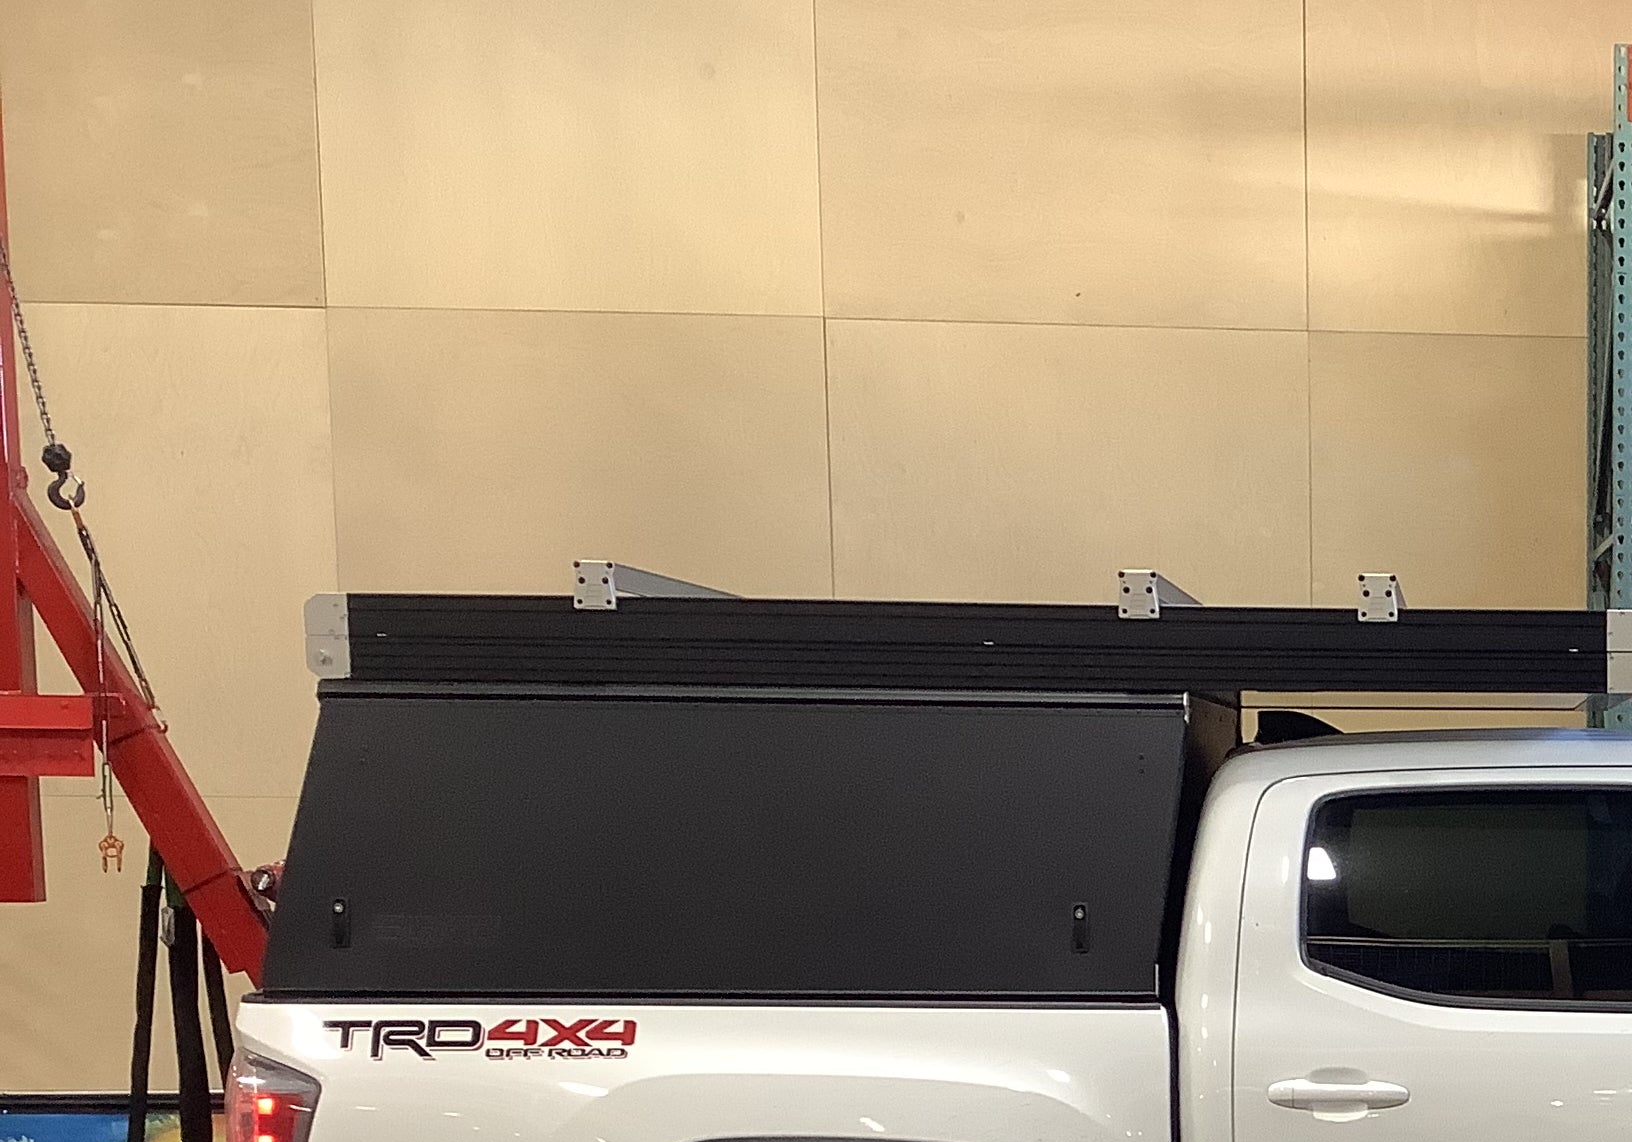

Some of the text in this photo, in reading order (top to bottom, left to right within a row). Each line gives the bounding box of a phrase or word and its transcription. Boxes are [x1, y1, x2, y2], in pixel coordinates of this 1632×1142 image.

[323, 1020, 486, 1060] TRD
[485, 1048, 628, 1060] OFF ROAD
